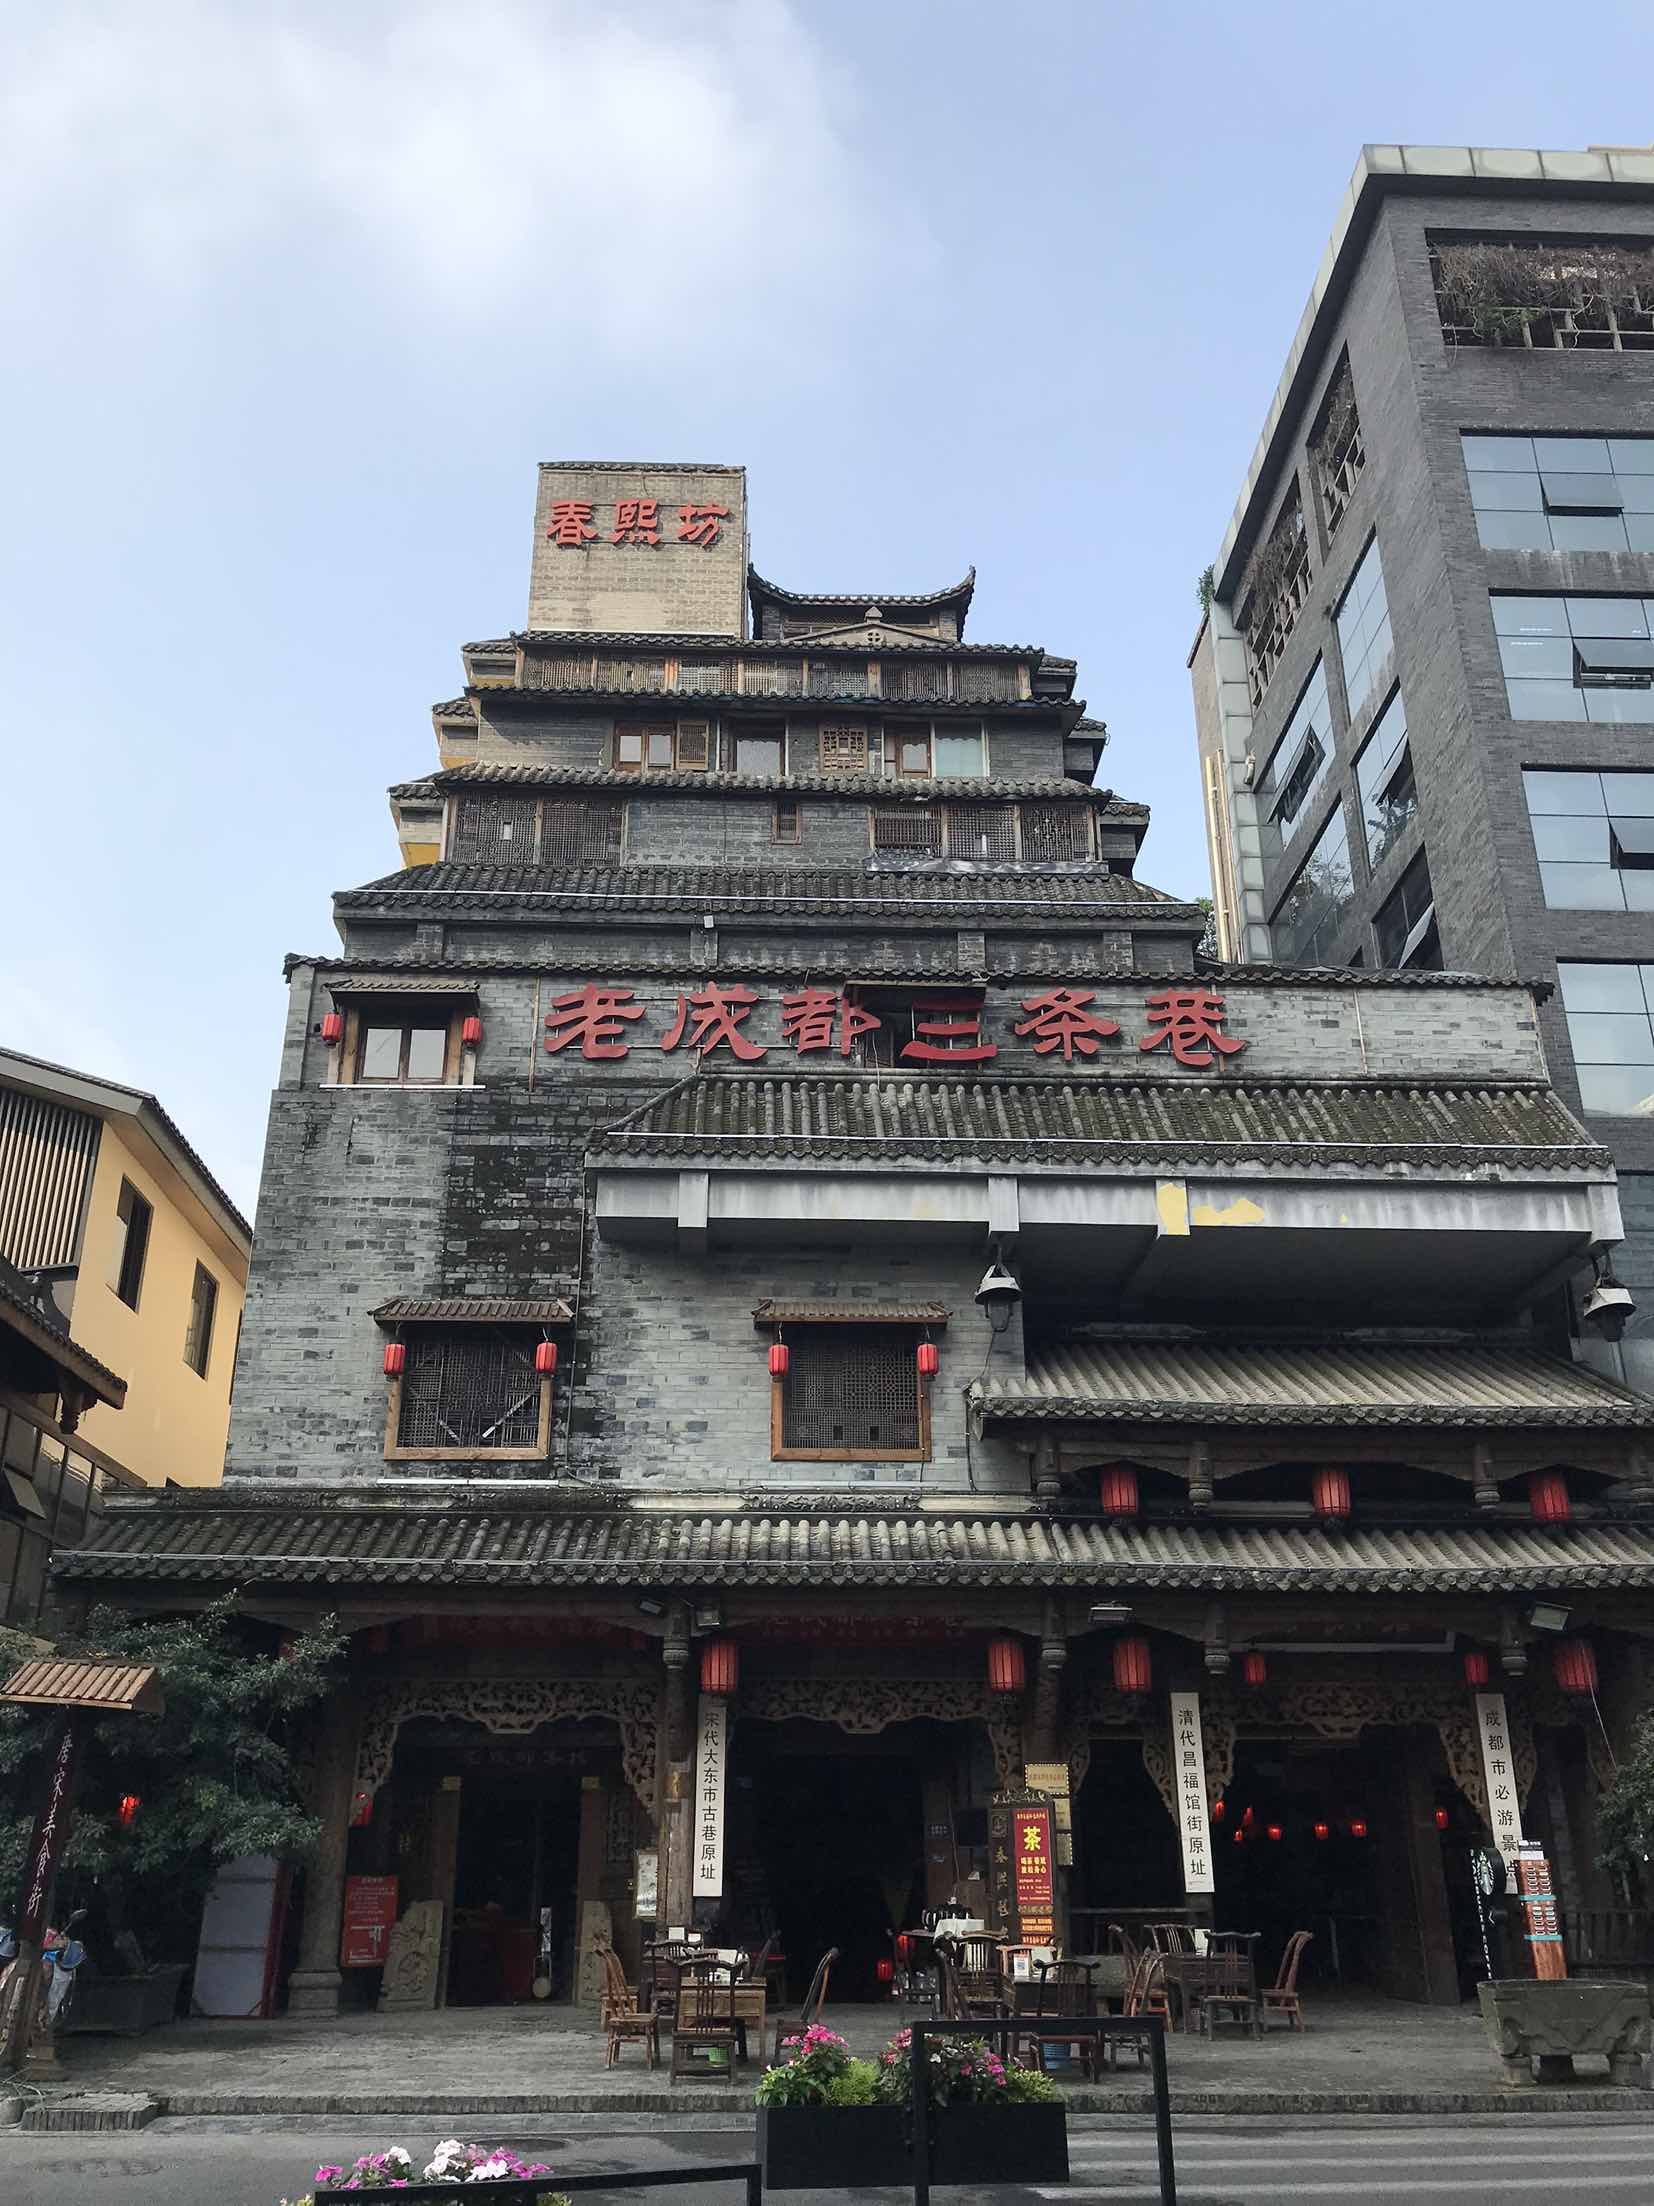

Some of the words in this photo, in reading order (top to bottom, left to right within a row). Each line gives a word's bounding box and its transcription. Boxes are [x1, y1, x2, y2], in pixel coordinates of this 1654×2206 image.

[547, 498, 730, 546] 春熙坊
[544, 982, 1246, 1066] 老成都三条巷
[700, 1712, 720, 1880] 宋代大东市古巷原址
[1023, 1826, 1042, 1851] 茶
[1178, 1710, 1207, 1876] 清代昌福馆街原址
[1485, 1711, 1519, 1876] 成都市必游景点
